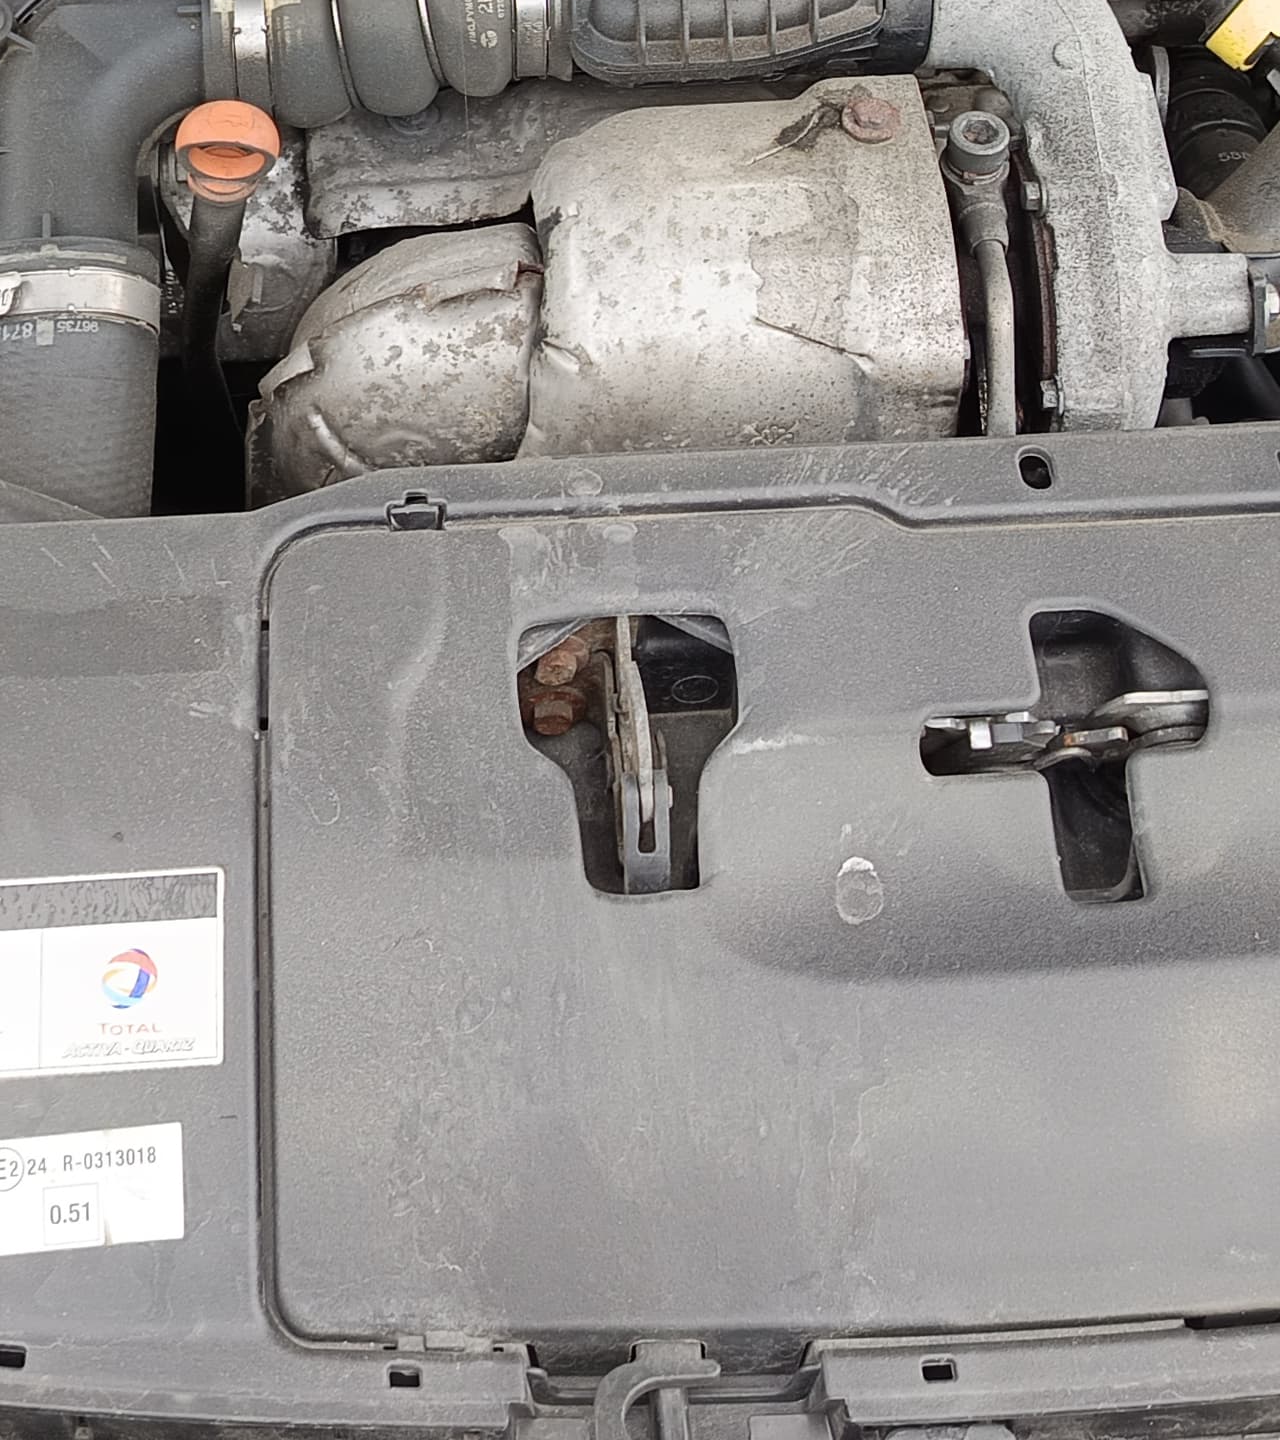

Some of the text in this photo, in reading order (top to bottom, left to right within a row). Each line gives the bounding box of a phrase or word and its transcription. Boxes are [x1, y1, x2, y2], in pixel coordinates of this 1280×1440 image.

[27, 1158, 47, 1176] 24
[63, 1146, 157, 1172] R-0313018
[49, 1201, 91, 1225] 0.51
